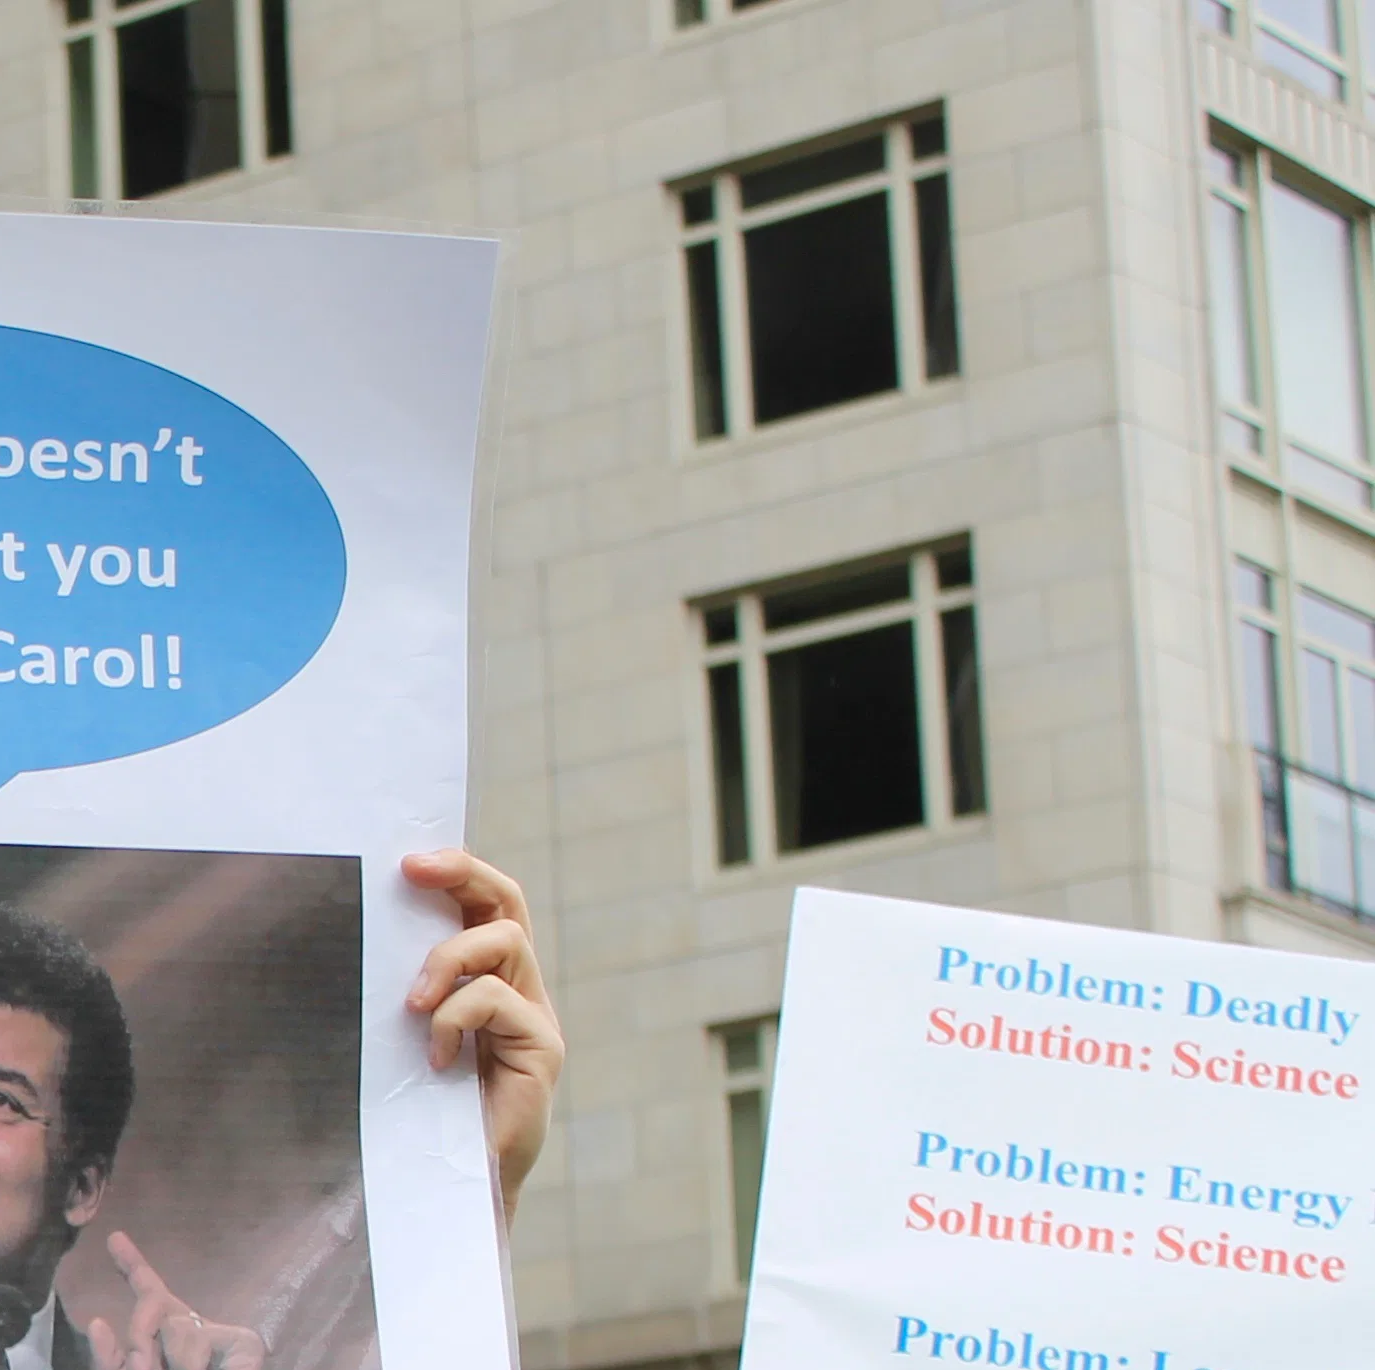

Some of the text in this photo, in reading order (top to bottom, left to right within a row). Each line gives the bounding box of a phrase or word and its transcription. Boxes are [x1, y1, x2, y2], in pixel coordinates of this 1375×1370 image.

[45, 542, 177, 598] you
[936, 945, 1360, 1046] Problem: Deadly
[926, 1008, 1360, 1100] Solution: Science
[913, 1130, 1147, 1197] Problem:
[1167, 1164, 1353, 1230] Energy
[905, 1193, 1347, 1283] Solution: Science
